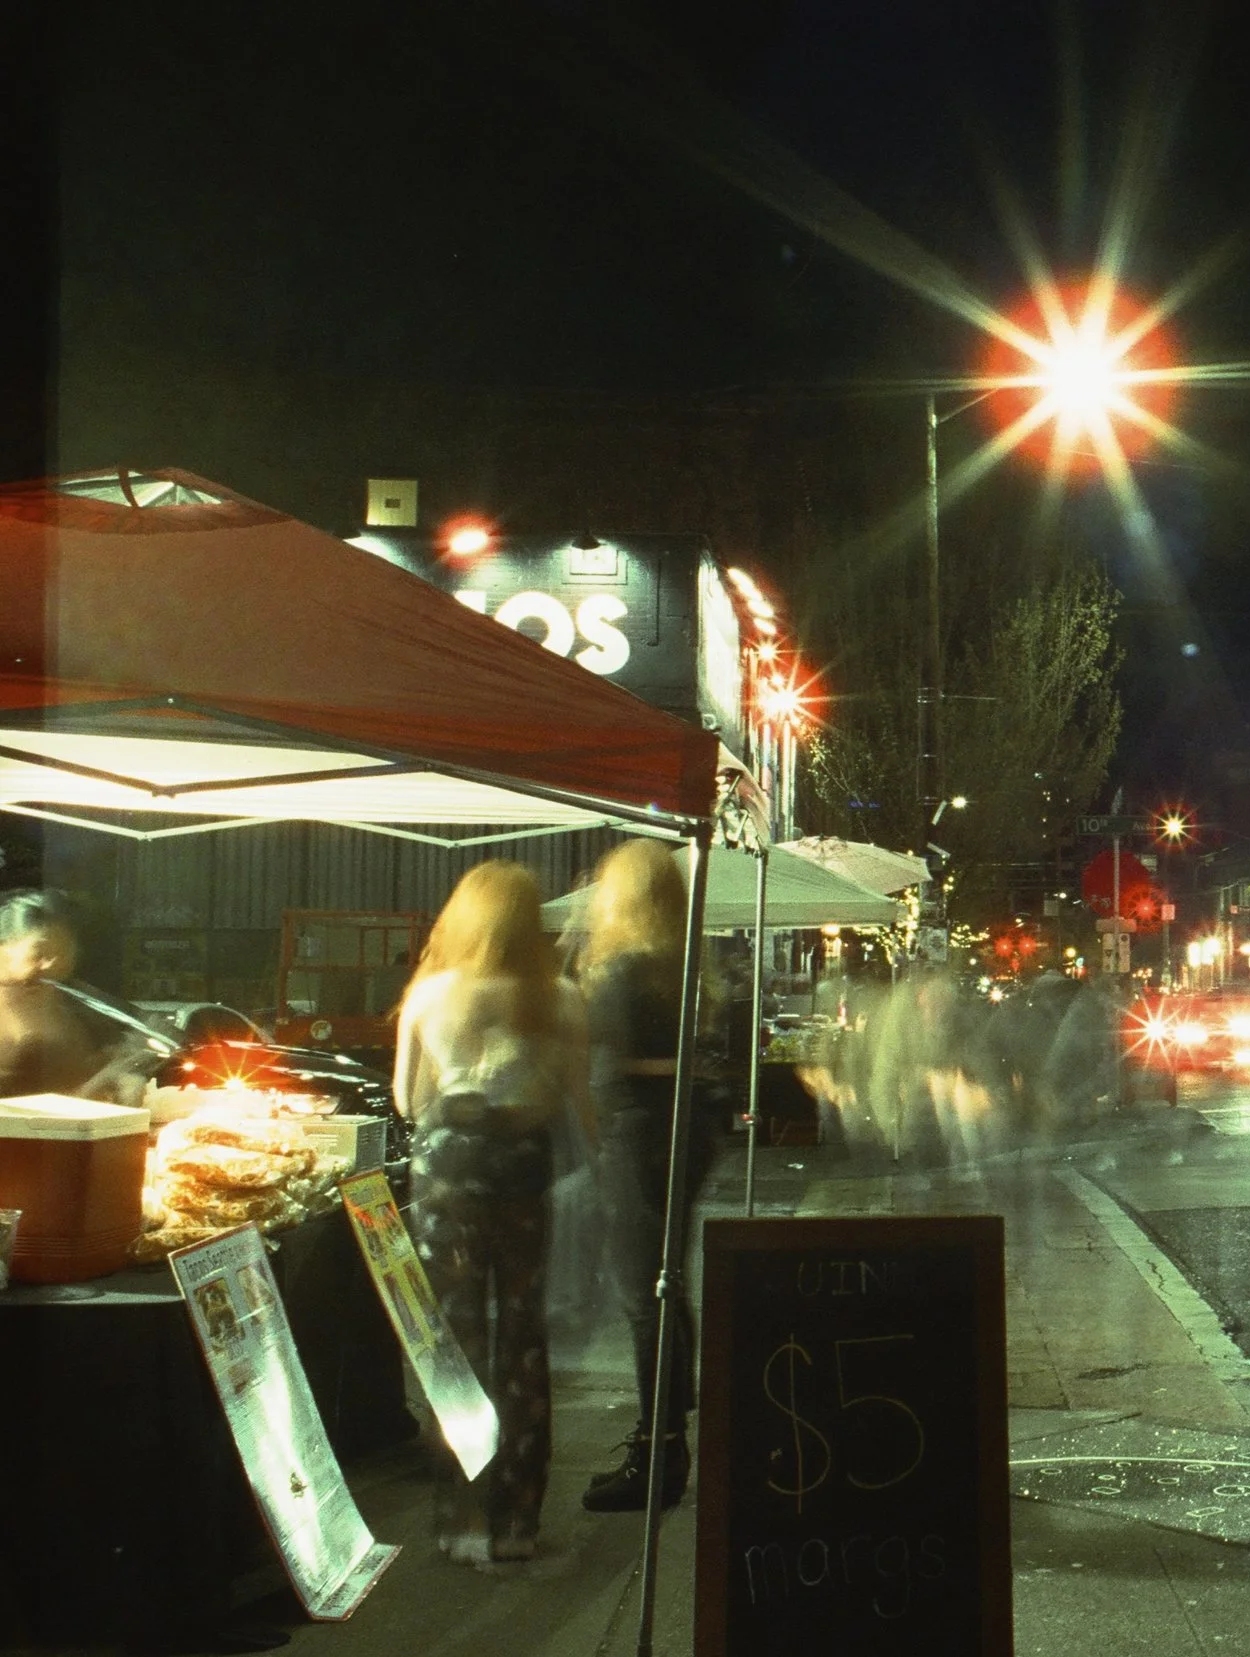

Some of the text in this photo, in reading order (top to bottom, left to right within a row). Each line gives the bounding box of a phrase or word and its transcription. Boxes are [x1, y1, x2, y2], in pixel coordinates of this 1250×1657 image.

[453, 589, 631, 675] OS
[761, 1333, 925, 1515] $5
[743, 1533, 949, 1620] margs
